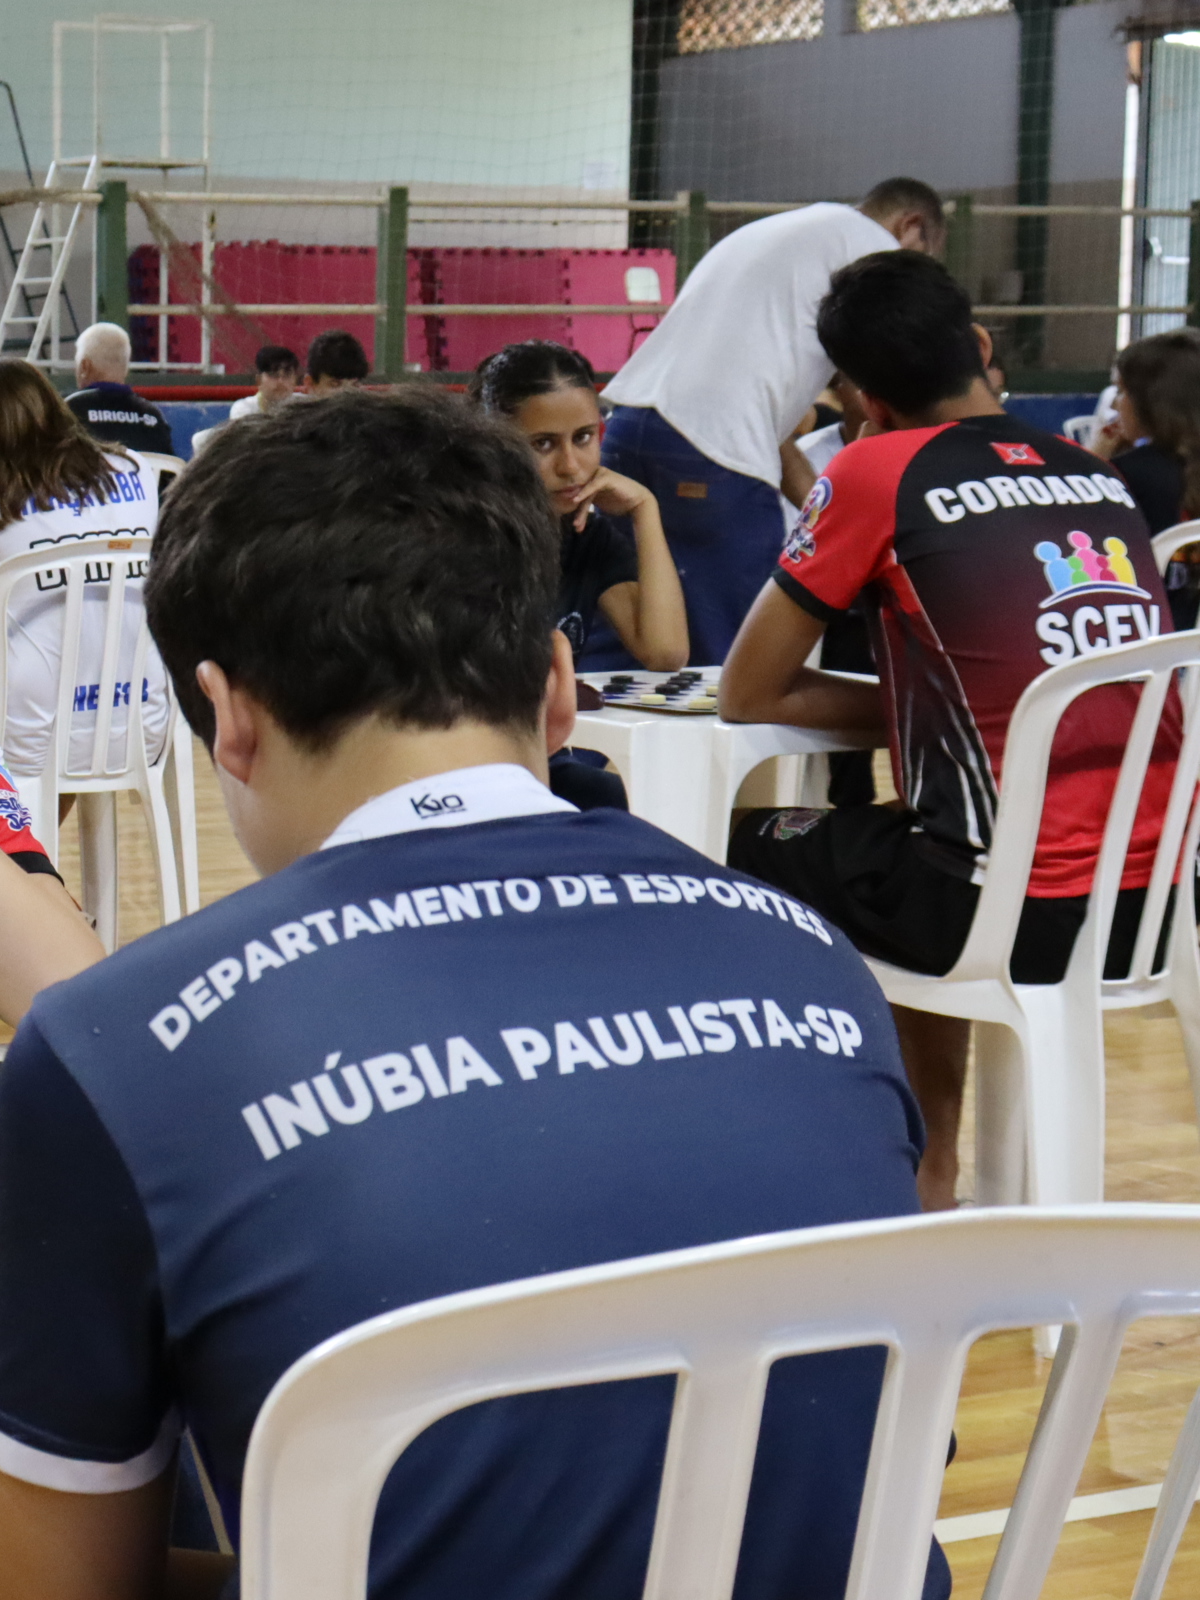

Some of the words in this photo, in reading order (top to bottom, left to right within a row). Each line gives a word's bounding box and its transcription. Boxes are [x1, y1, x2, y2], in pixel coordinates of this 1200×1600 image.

[87, 409, 158, 427] BIRIGUI-SP
[924, 473, 1136, 523] COROADOS
[148, 877, 542, 1052] DEPARTAMENTO
[547, 873, 619, 908] DE
[619, 873, 834, 947] ESPORTES
[241, 1036, 504, 1162] INÚBIA
[499, 998, 863, 1082] PAULISTA-SP
